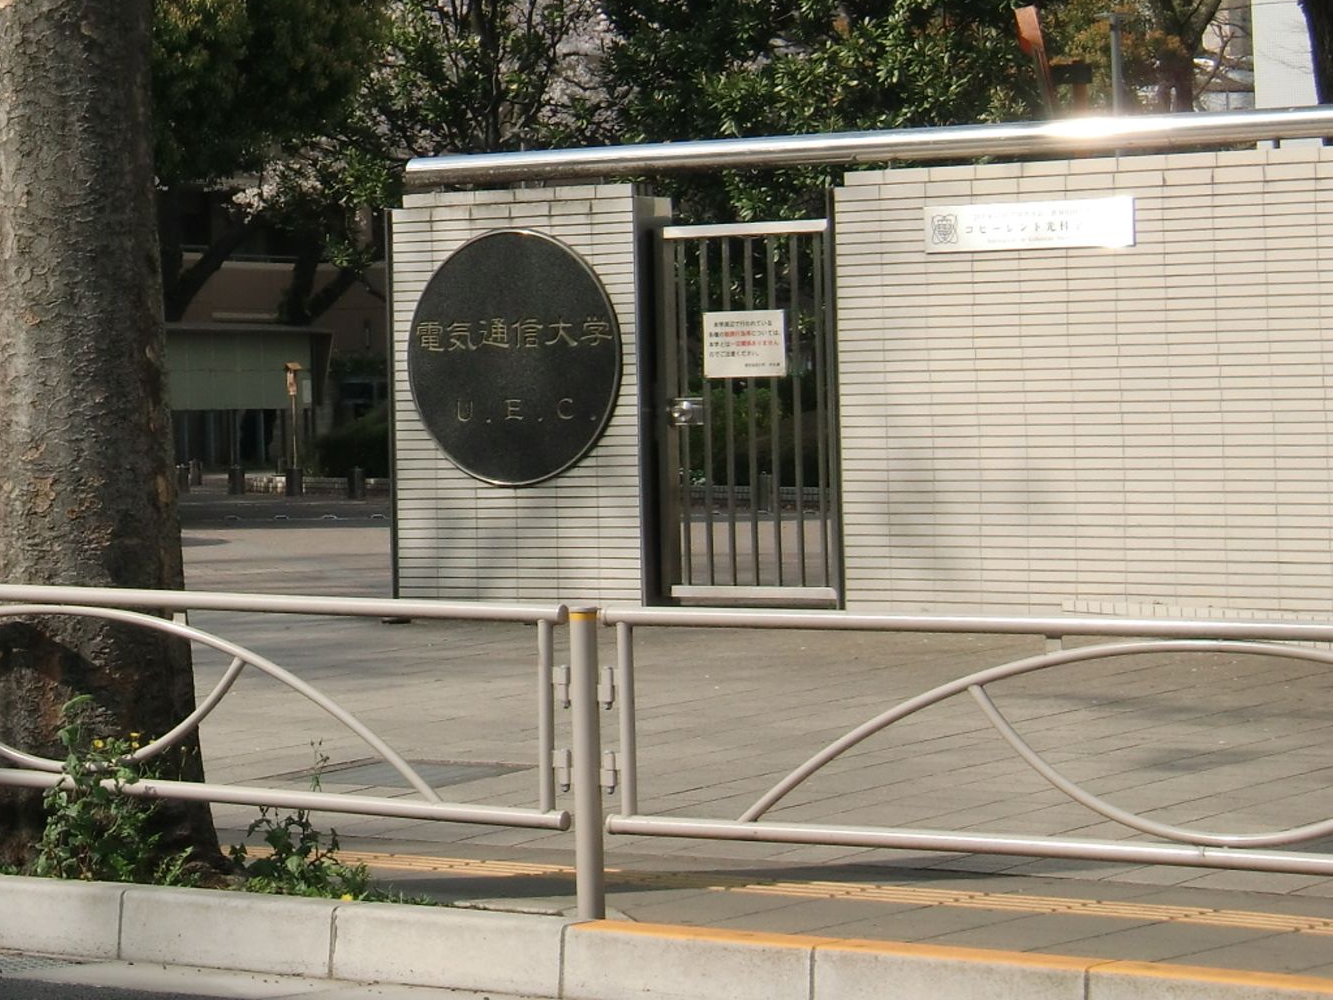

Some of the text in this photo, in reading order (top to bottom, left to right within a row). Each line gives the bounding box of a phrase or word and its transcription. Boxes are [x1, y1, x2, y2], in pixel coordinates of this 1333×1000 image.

[965, 220, 1081, 234] コヒーレント光科
[416, 317, 614, 352] 電気通信大学
